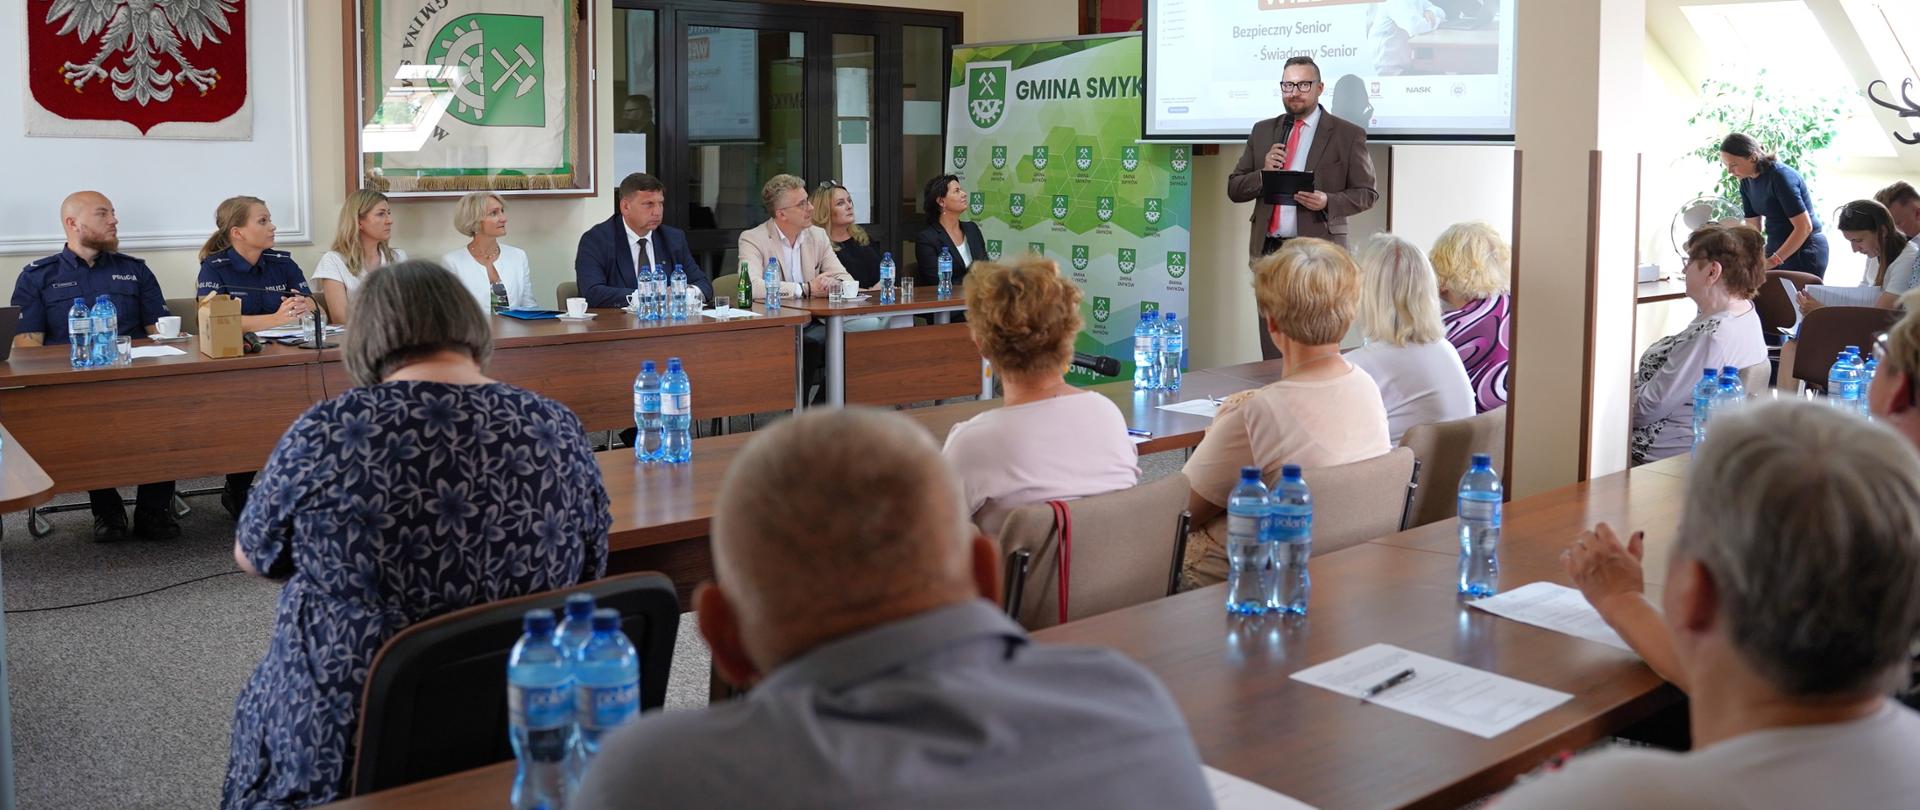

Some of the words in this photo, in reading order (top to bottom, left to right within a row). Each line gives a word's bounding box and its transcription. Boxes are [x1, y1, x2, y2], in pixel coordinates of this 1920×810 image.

[1232, 23, 1293, 39] Bezpieczny
[1295, 21, 1332, 35] Senior
[1260, 45, 1317, 61] Świadomy
[1320, 44, 1358, 58] Senior
[1016, 77, 1081, 100] GMINA
[1405, 86, 1432, 94] NASK
